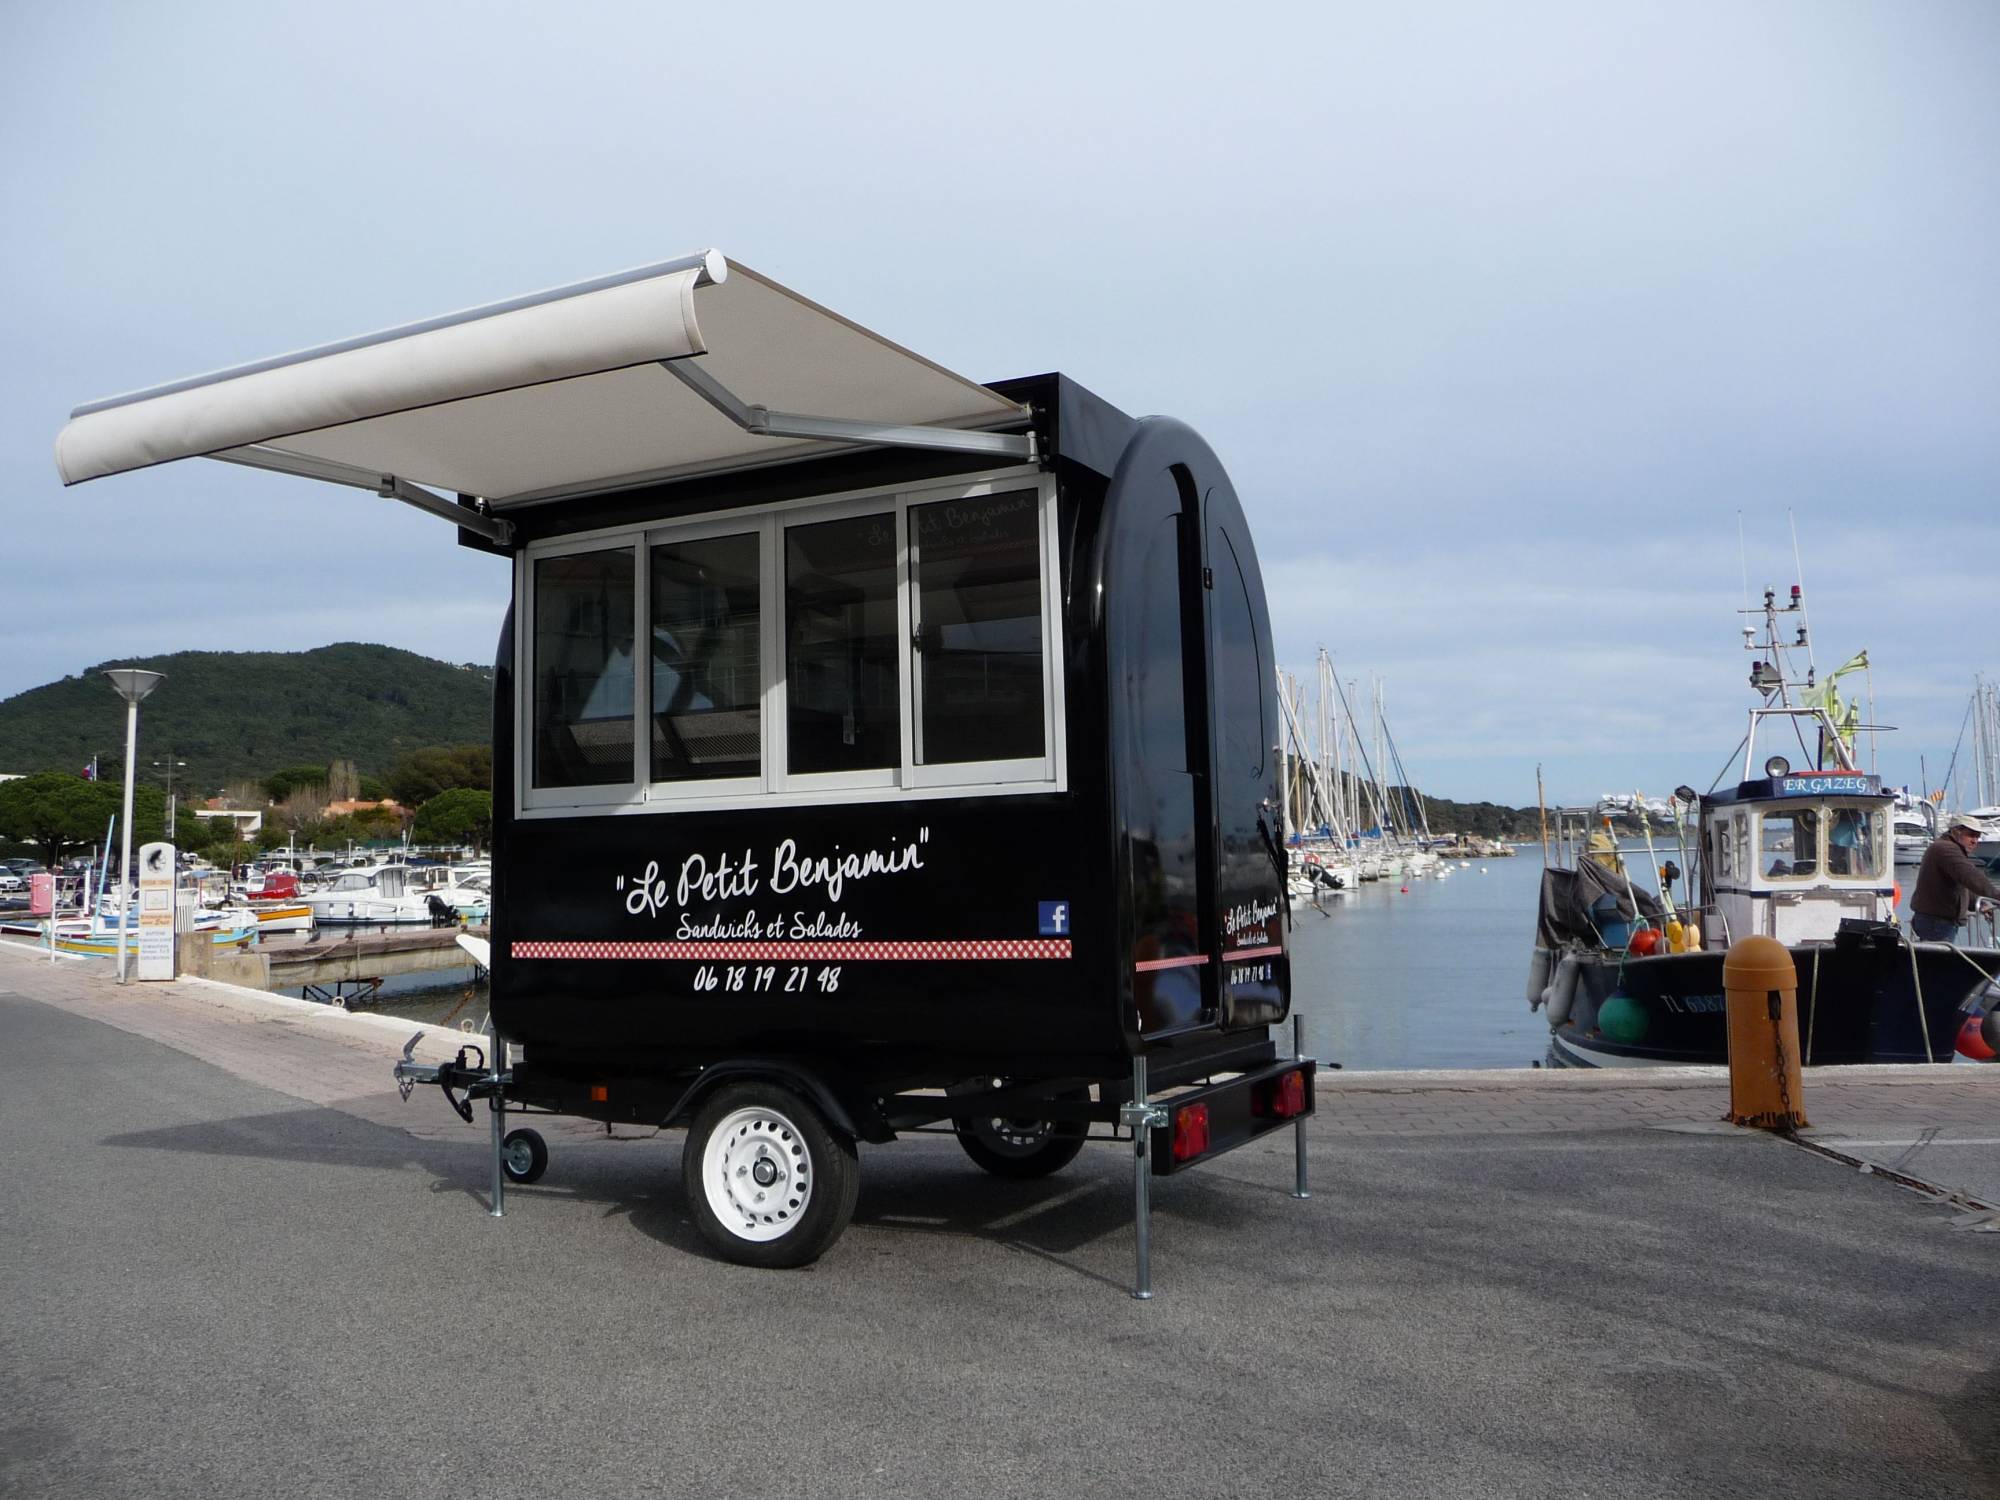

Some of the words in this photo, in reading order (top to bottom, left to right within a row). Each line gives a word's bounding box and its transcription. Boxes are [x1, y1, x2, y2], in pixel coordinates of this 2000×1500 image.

[1783, 778, 1810, 793] ER
[677, 848, 758, 906] Petit
[676, 909, 764, 940] Sandwichs
[766, 913, 785, 939] et
[789, 911, 863, 940] Salades
[693, 965, 719, 992] 06
[725, 965, 747, 992] 18
[753, 965, 776, 992] 19
[784, 965, 809, 992] 21
[816, 965, 842, 993] 48
